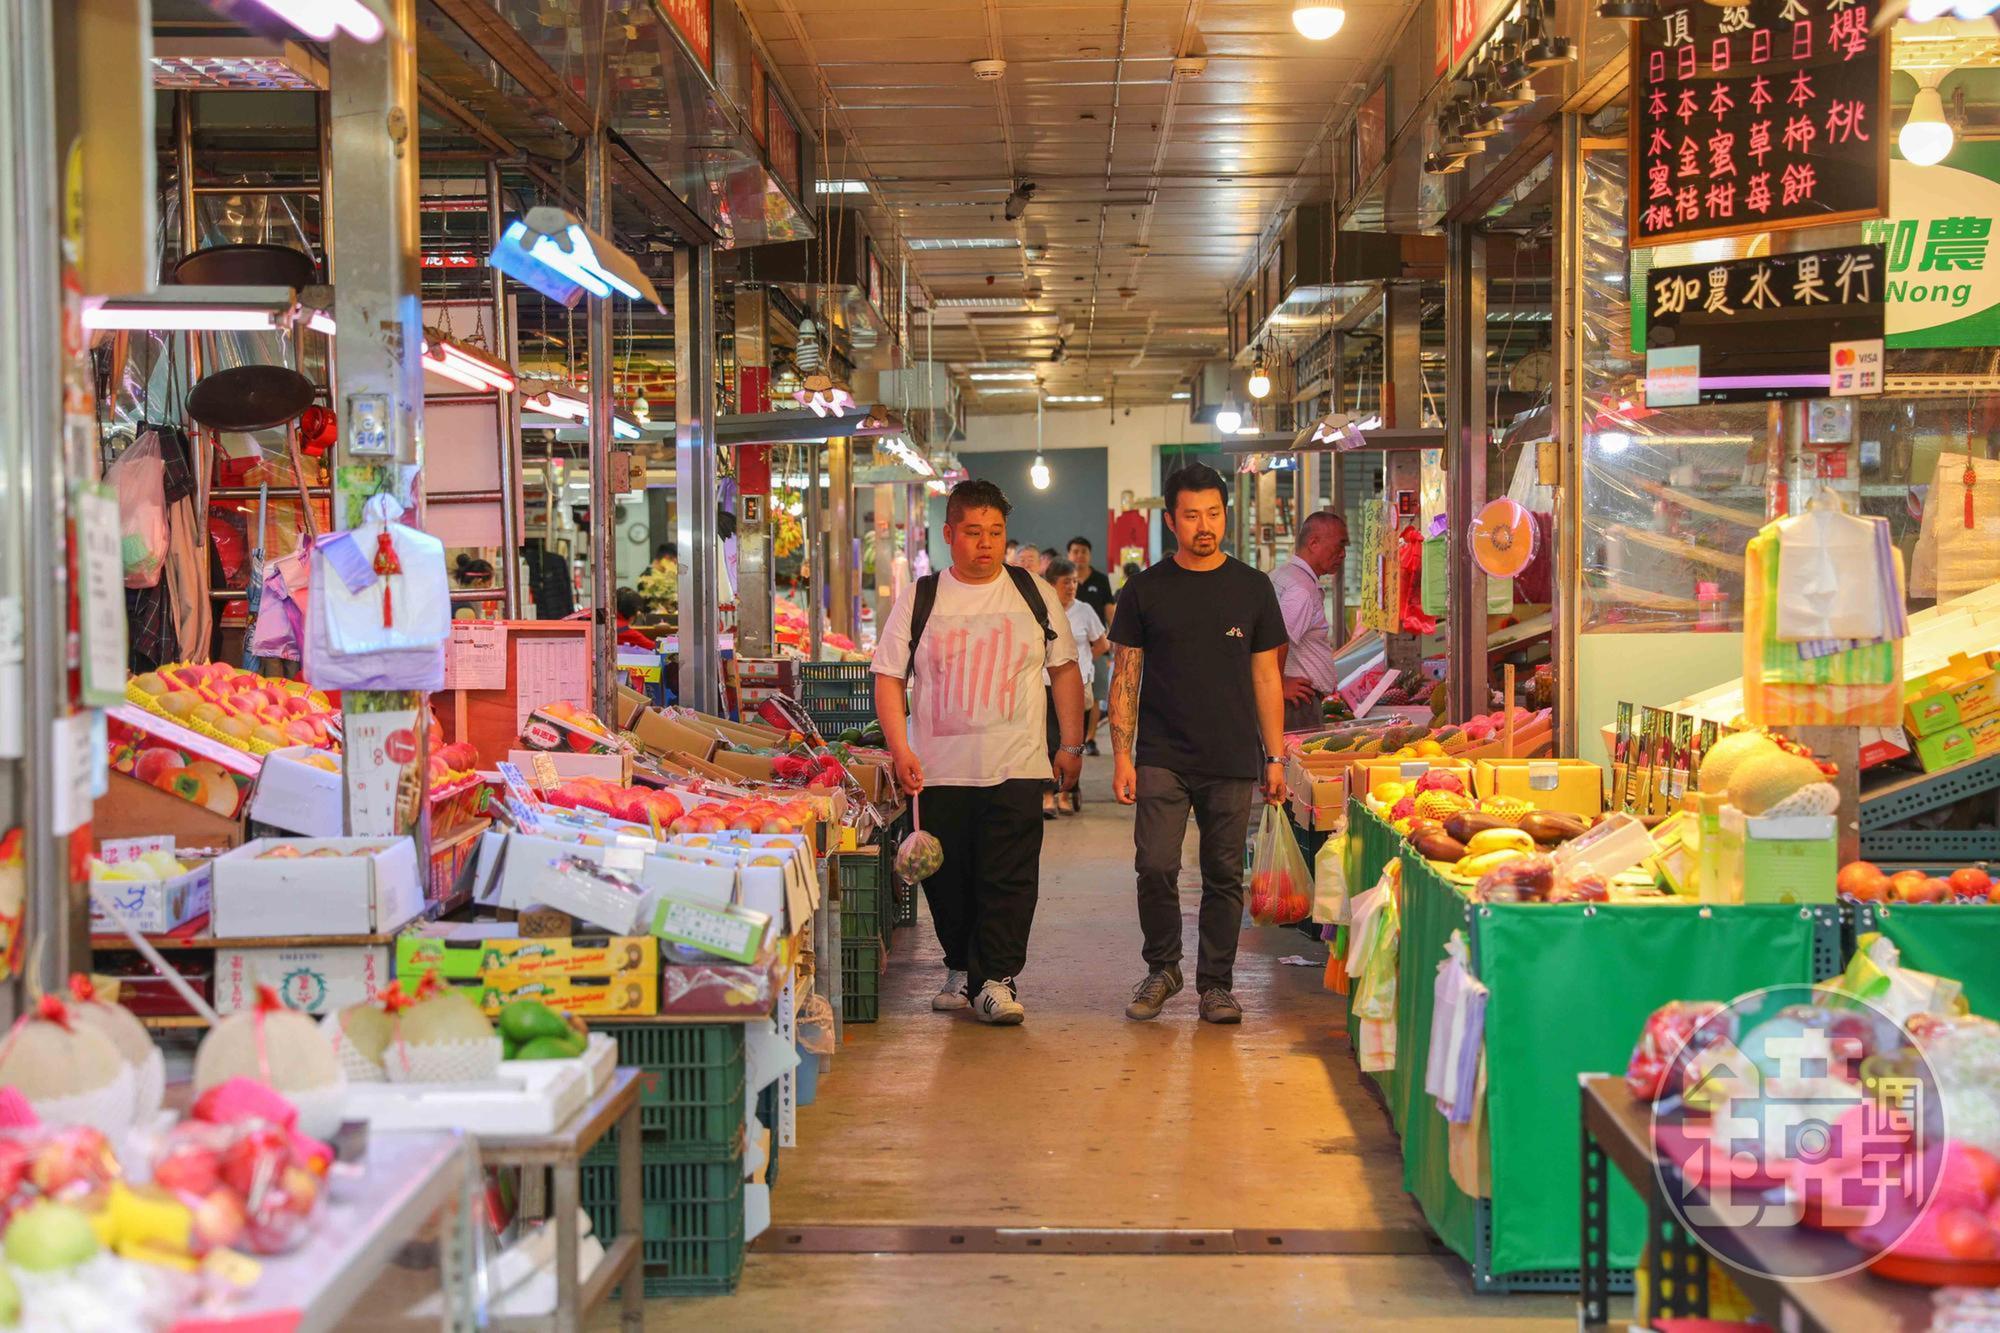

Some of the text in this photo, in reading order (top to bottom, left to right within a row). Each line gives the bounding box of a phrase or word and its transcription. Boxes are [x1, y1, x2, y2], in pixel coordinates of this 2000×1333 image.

[1645, 51, 1675, 232] 日本水蜜桃
[1675, 45, 1701, 223] 日本金桔
[1704, 37, 1738, 219] 日本蜜柑
[1780, 20, 1817, 205] 日本柿餅
[1825, 6, 1869, 144] 櫻桃
[1653, 253, 1875, 318] 珈農水果行
[1858, 353, 1878, 363] VISA
[1884, 281, 1972, 307] Nong
